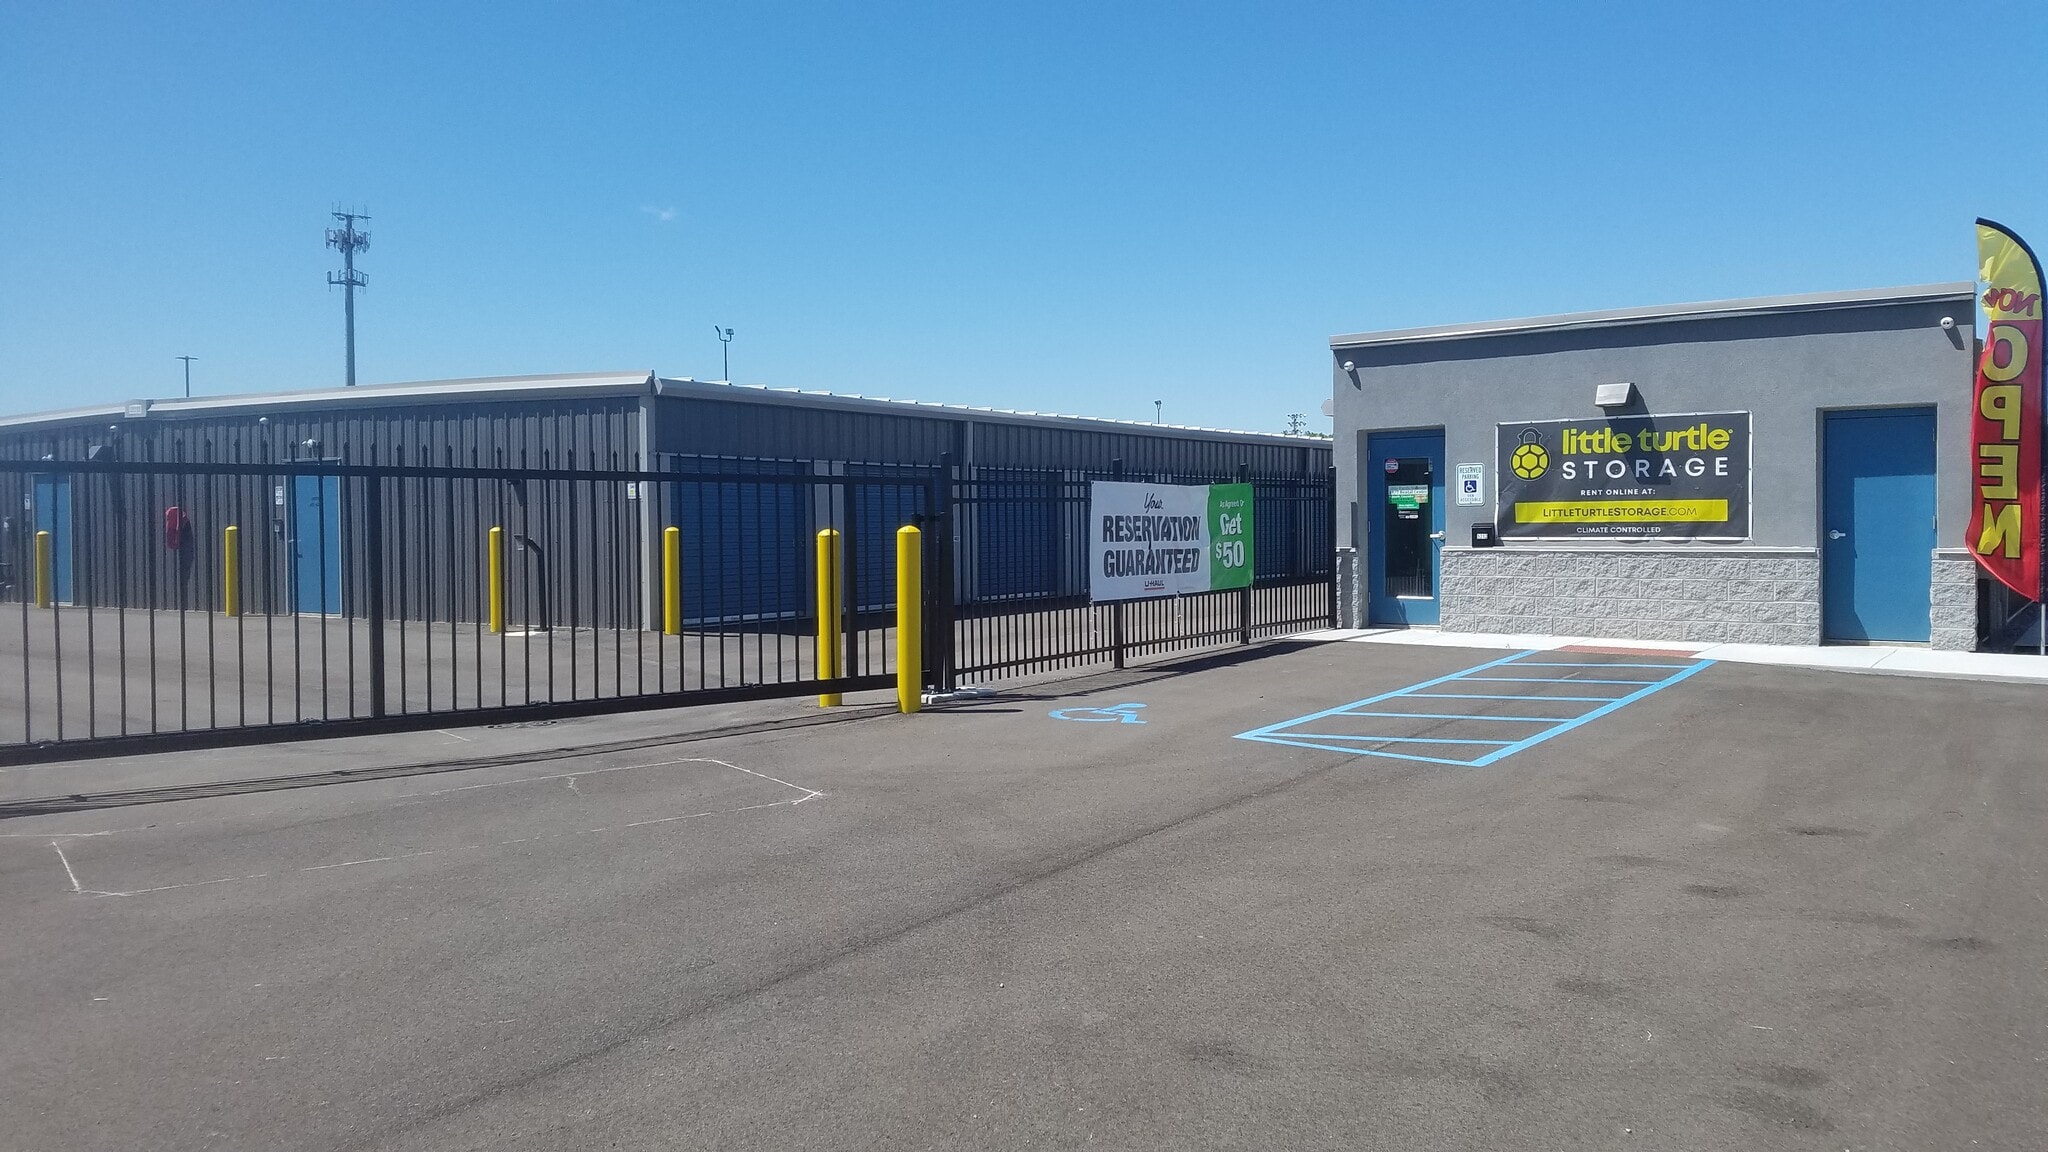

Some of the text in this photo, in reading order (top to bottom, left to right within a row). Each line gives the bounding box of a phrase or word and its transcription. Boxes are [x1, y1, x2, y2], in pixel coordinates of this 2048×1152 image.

[1562, 423, 1730, 455] little turtle
[1459, 466, 1482, 474] RESERVED
[1562, 457, 1729, 480] STORAGE
[1605, 488, 1639, 496] ONLINE
[1102, 515, 1201, 543] RESERVATION
[1220, 512, 1242, 536] Get
[1103, 547, 1201, 578] GUARANTEED
[1215, 540, 1245, 569] $50
